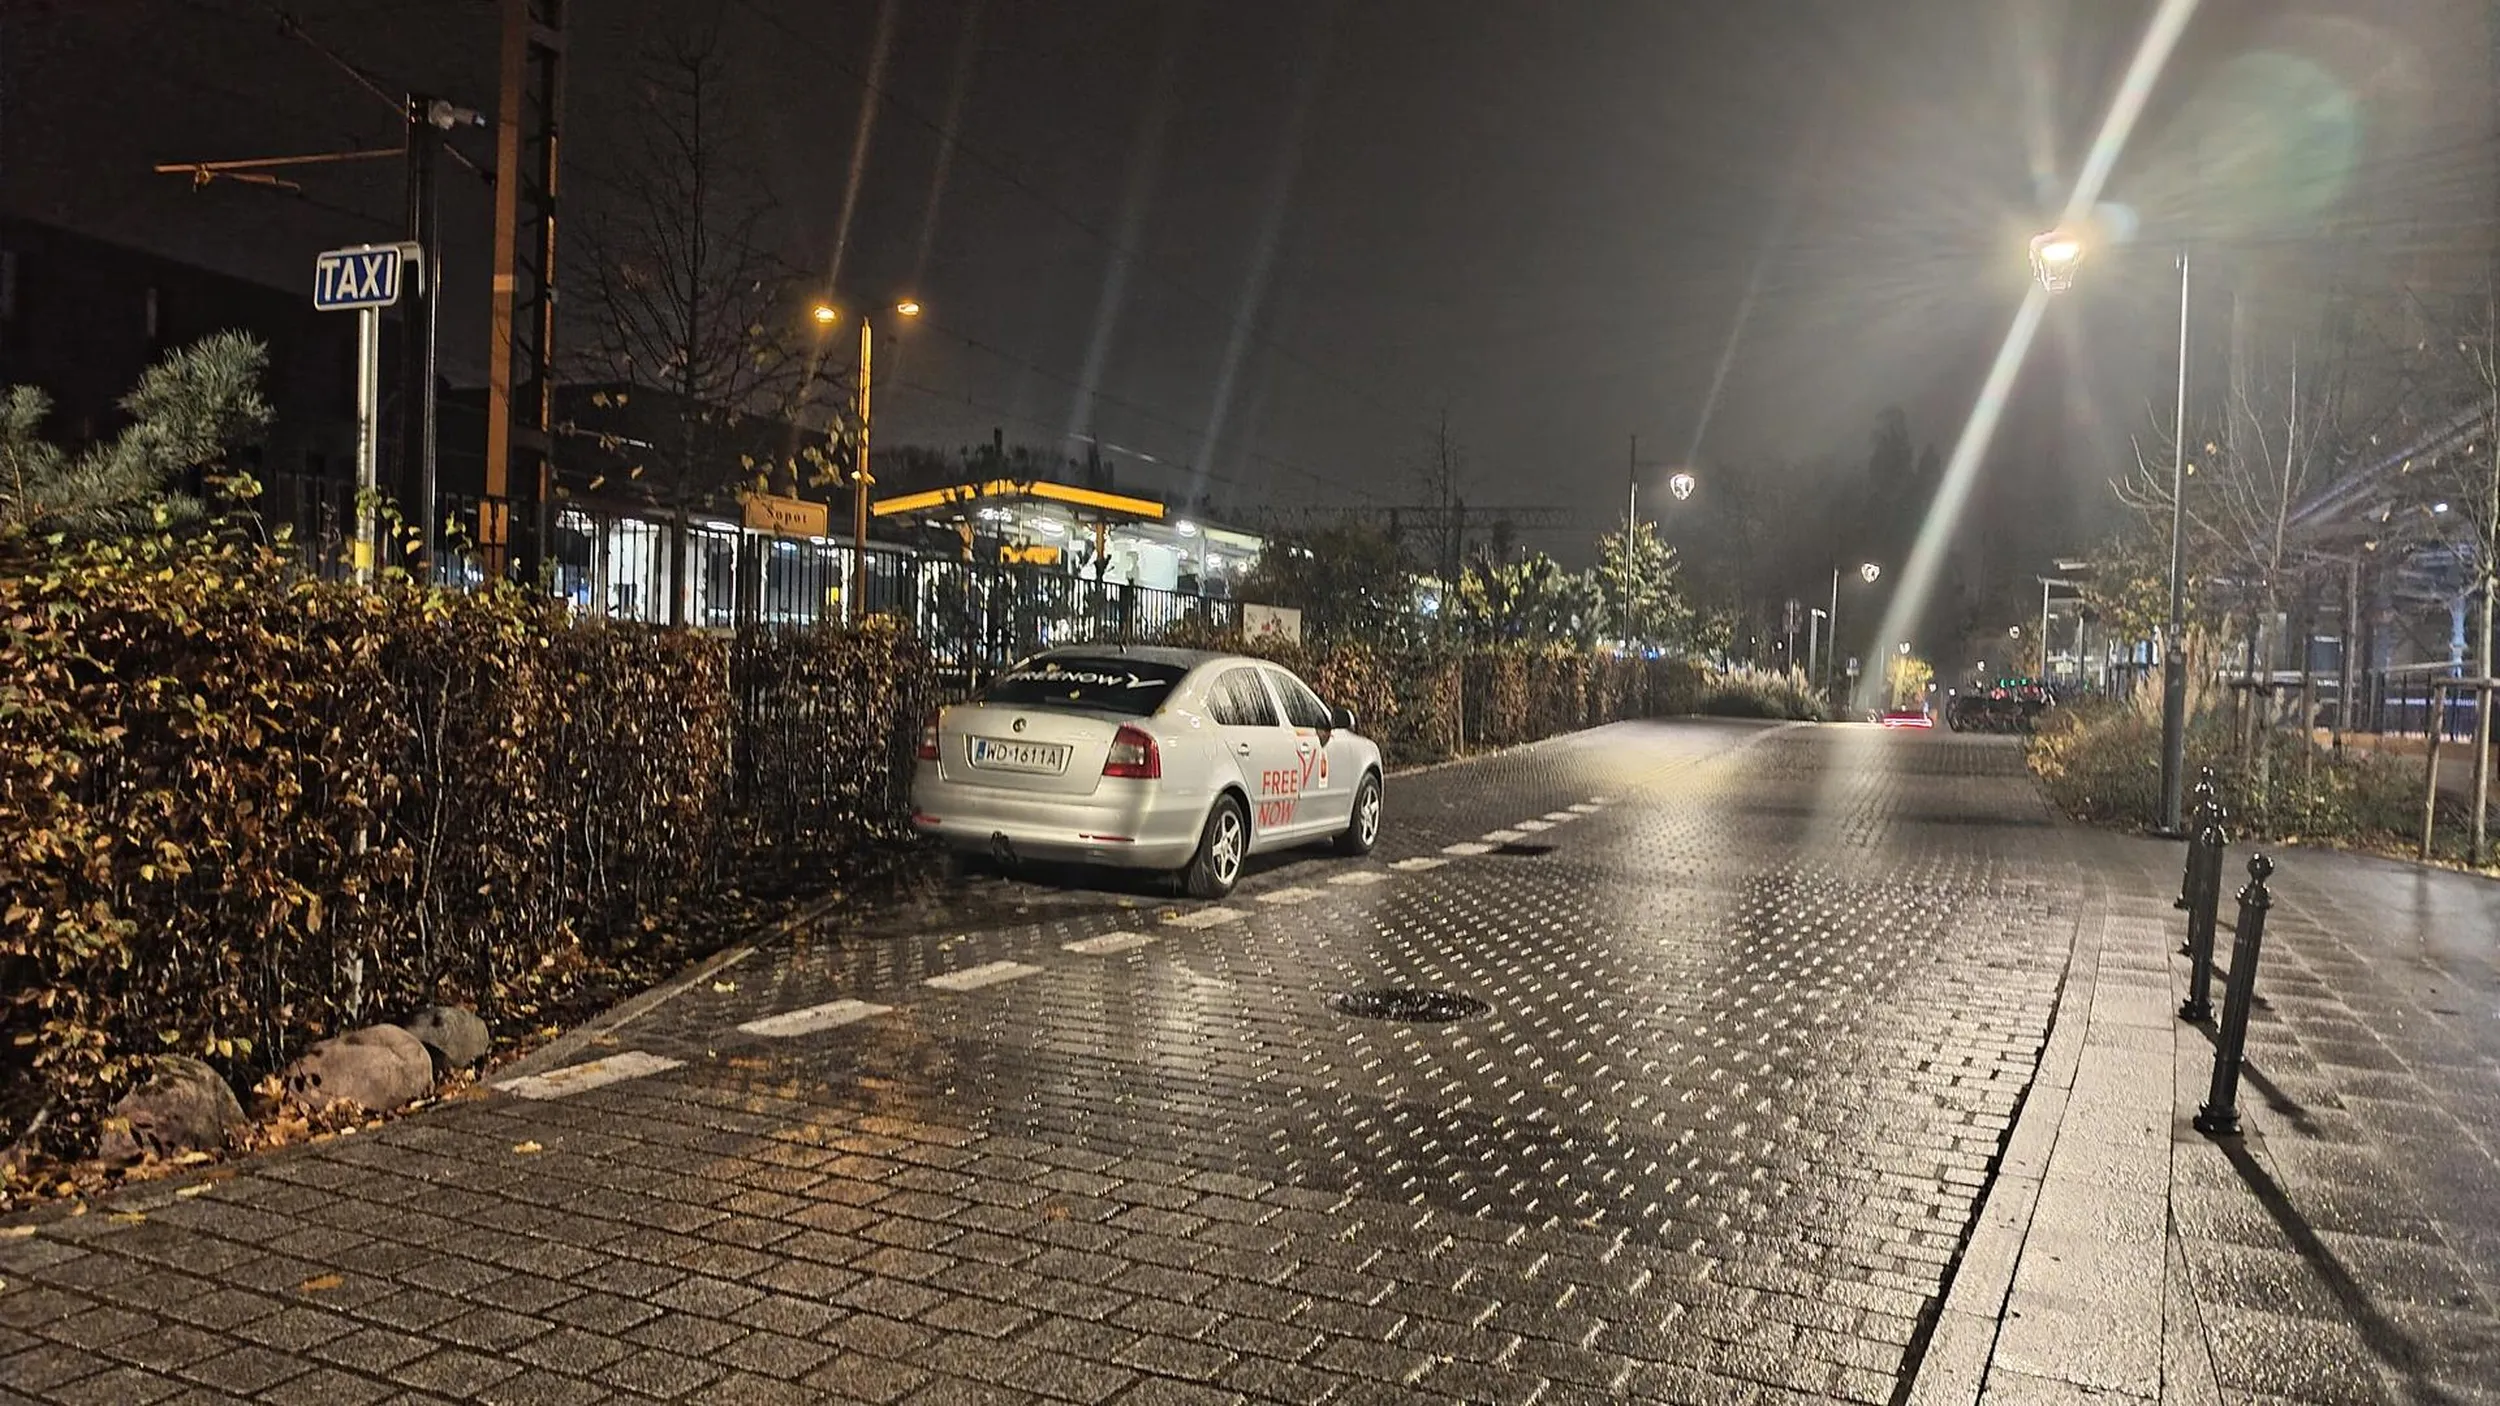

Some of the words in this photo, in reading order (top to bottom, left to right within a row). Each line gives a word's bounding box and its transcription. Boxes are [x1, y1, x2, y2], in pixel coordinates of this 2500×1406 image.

[320, 253, 394, 301] TAXI
[766, 507, 807, 525] Sopot
[1262, 769, 1298, 795] FREE
[1258, 799, 1297, 828] NOW
